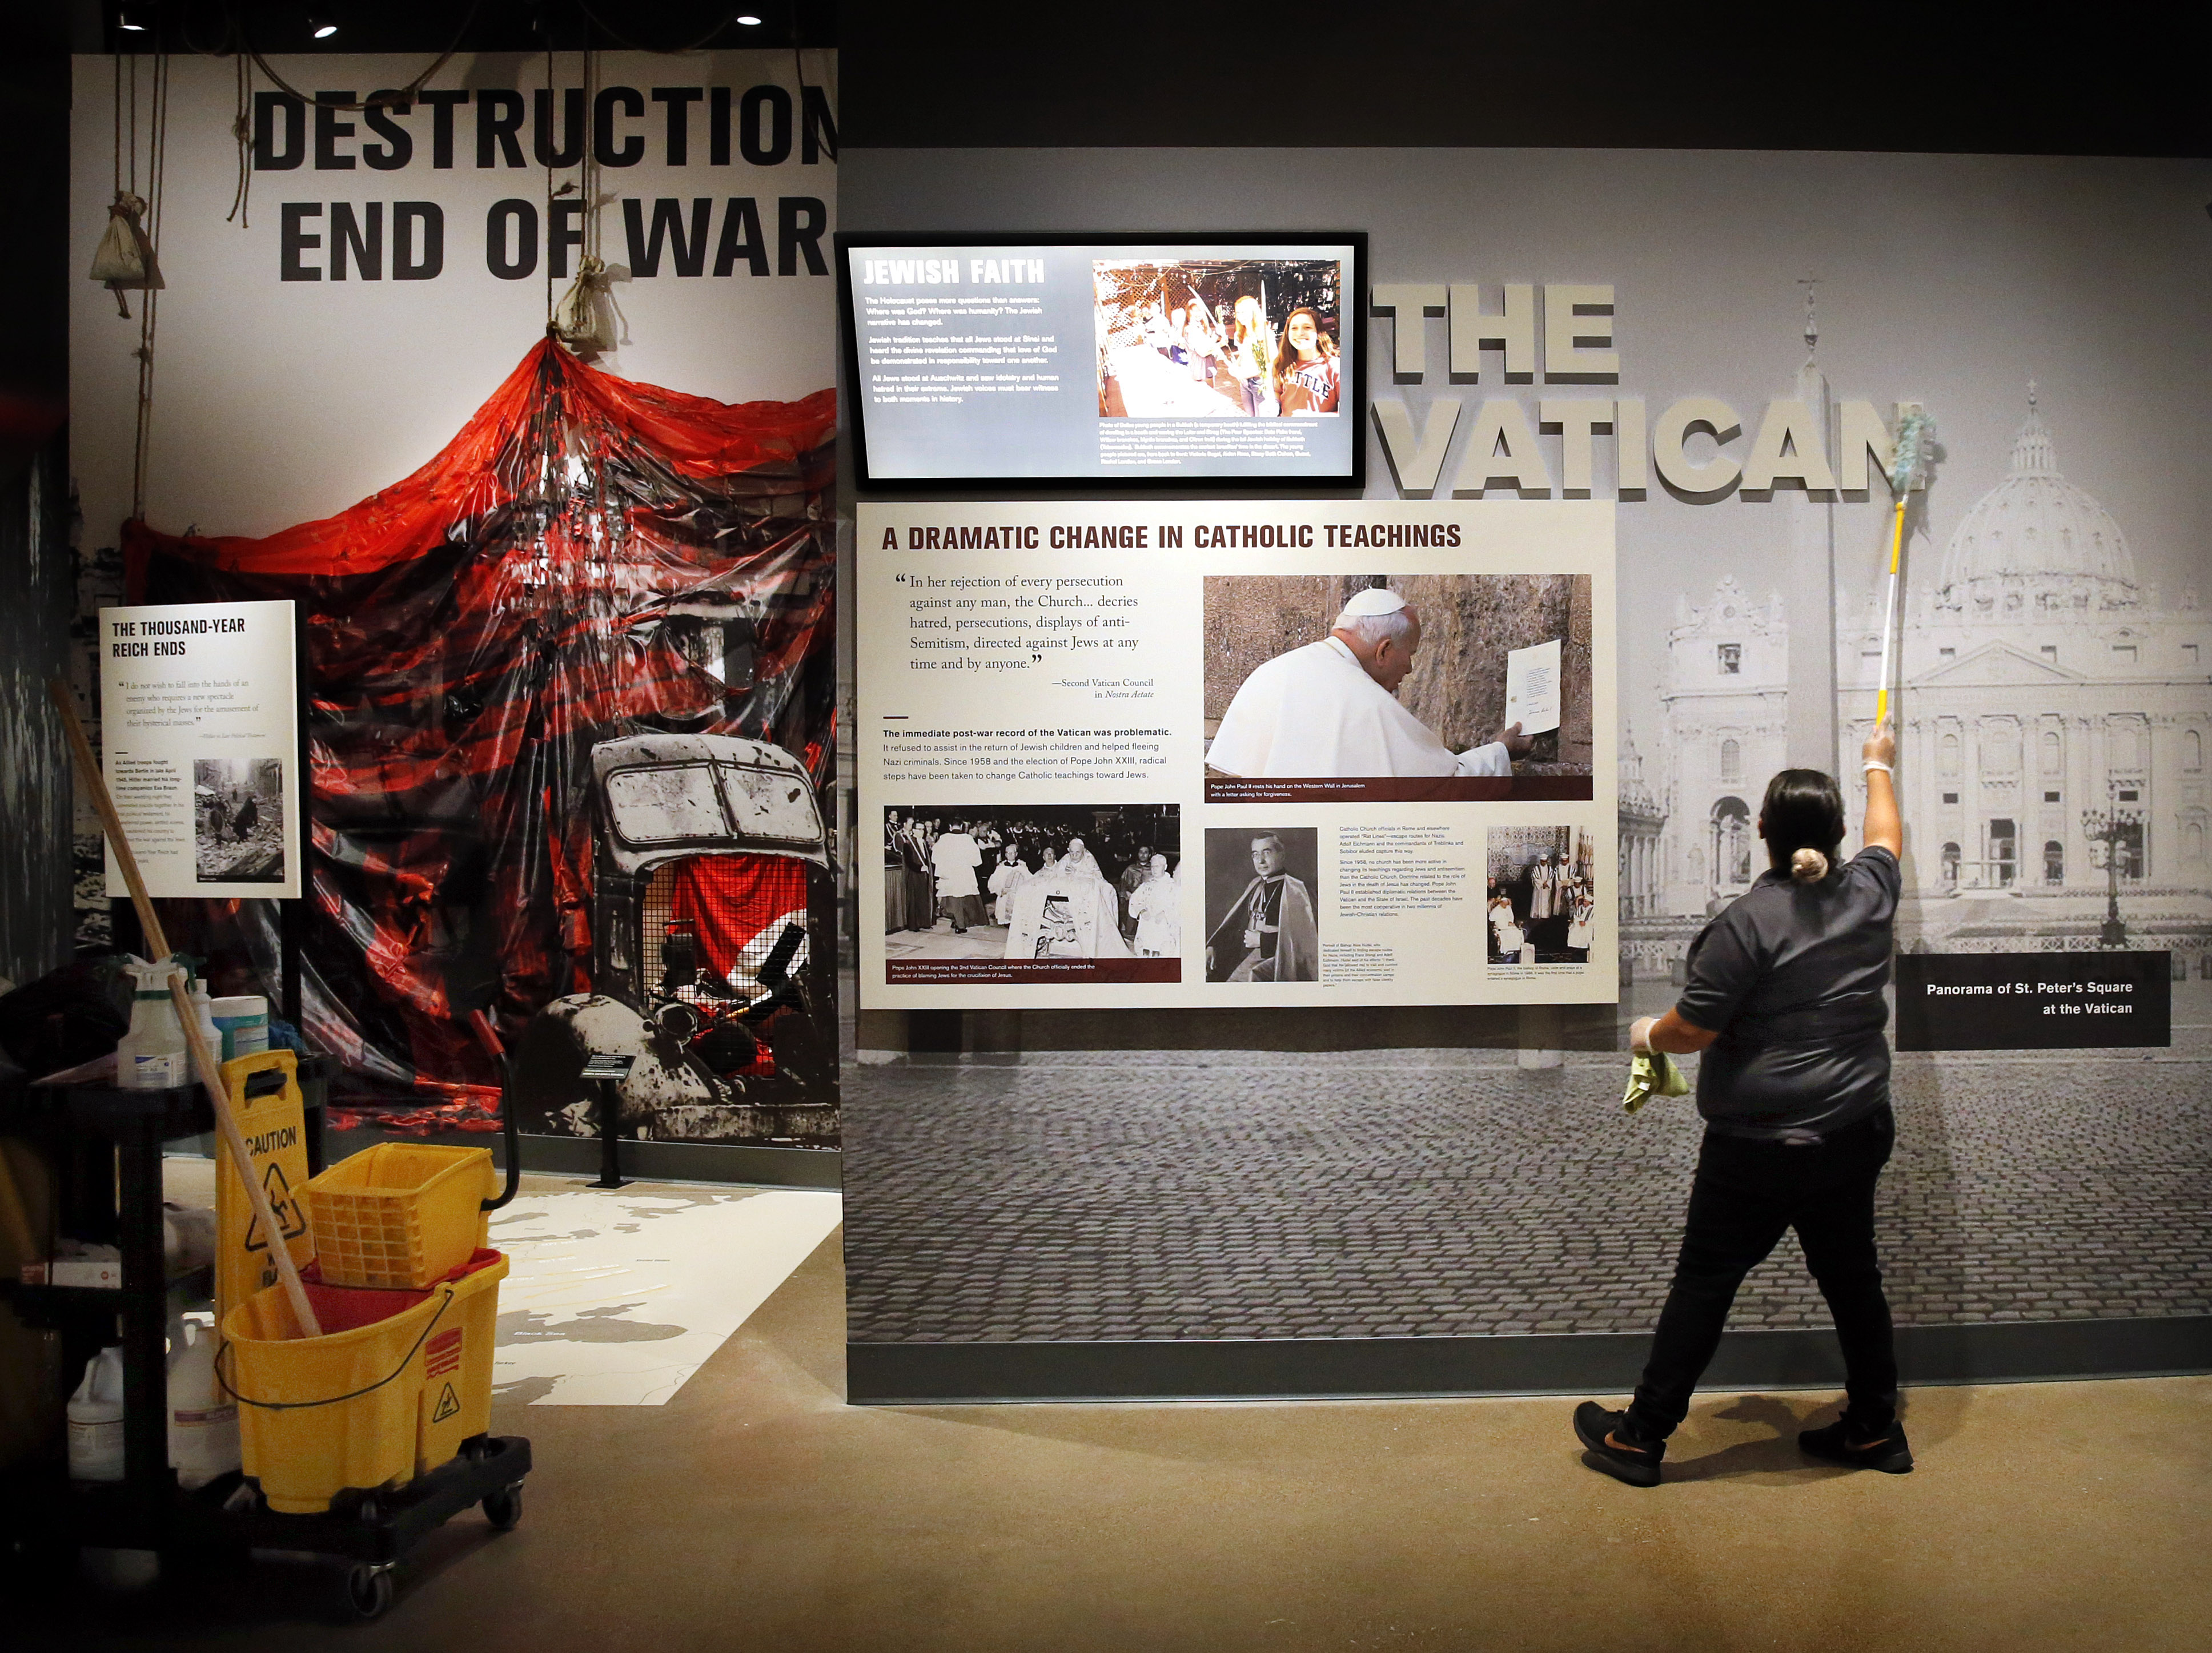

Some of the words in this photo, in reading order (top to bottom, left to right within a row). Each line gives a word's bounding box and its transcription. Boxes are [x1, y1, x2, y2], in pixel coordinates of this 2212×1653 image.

[254, 86, 838, 171] DESTRUCTION
[281, 201, 444, 282] END
[487, 198, 588, 280] OF
[623, 196, 830, 278] WAR
[864, 258, 960, 284] JEWISH
[970, 258, 1045, 284] FAITH
[968, 307, 1003, 316] humanity?
[911, 317, 944, 327] changed.
[1371, 284, 1619, 381] THE
[1371, 399, 1926, 498] VATICAN
[882, 527, 898, 550] A
[909, 526, 1039, 550] DRAMATIC
[1050, 525, 1148, 549] CHANGE
[1159, 525, 1183, 548] IN
[1194, 525, 1313, 548] CATHOLIC
[1323, 524, 1461, 548] TEACHINGS
[928, 576, 946, 587] her
[950, 576, 1001, 591] rejection
[1005, 574, 1019, 587] of
[1021, 578, 1053, 590] every
[1056, 576, 1123, 590] persecution
[910, 597, 952, 612] against
[956, 600, 977, 612] any
[981, 600, 1010, 609] man,
[1015, 596, 1034, 607] the
[1038, 595, 1093, 607] Church...
[1098, 594, 1138, 606] decries
[112, 622, 135, 637] THE
[140, 618, 245, 634] THOUSAND-YEAR
[910, 616, 951, 630] hatred,
[956, 617, 1031, 632] persecutions,
[1036, 615, 1082, 632] displays
[1086, 615, 1100, 627] of
[1102, 616, 1130, 627] anti-
[113, 642, 148, 658] REICH
[154, 641, 186, 656] ENDS
[910, 637, 969, 650] Semitism,
[974, 636, 1021, 648] directed
[1026, 637, 1068, 652] against
[1070, 636, 1098, 651] Jews
[1103, 638, 1114, 647] at
[1118, 640, 1139, 651] any
[910, 658, 937, 669] time
[941, 657, 963, 669] and
[967, 657, 981, 673] by
[1091, 678, 1120, 687] Vatican
[953, 730, 993, 739] post-war
[1114, 728, 1171, 738] problematic.
[891, 743, 921, 752] refused
[1102, 742, 1130, 753] helped
[1132, 742, 1159, 752] fleeing
[944, 757, 968, 766] Since
[1070, 757, 1092, 766] Pope
[1115, 756, 1137, 765] XXIII,
[884, 773, 906, 782] steps
[986, 771, 1016, 781] change
[1018, 771, 1052, 779] Catholic
[1054, 771, 1094, 781] teachings
[1927, 984, 1993, 995] Panorama
[1997, 983, 2011, 994] of
[2015, 983, 2033, 994] St.
[2037, 982, 2083, 994] Peter’s
[2087, 982, 2133, 995] Square
[2043, 1004, 2056, 1015] at
[2060, 1003, 2081, 1014] the
[2085, 1003, 2132, 1014] Vatican
[246, 1126, 296, 1157] CAUTION
